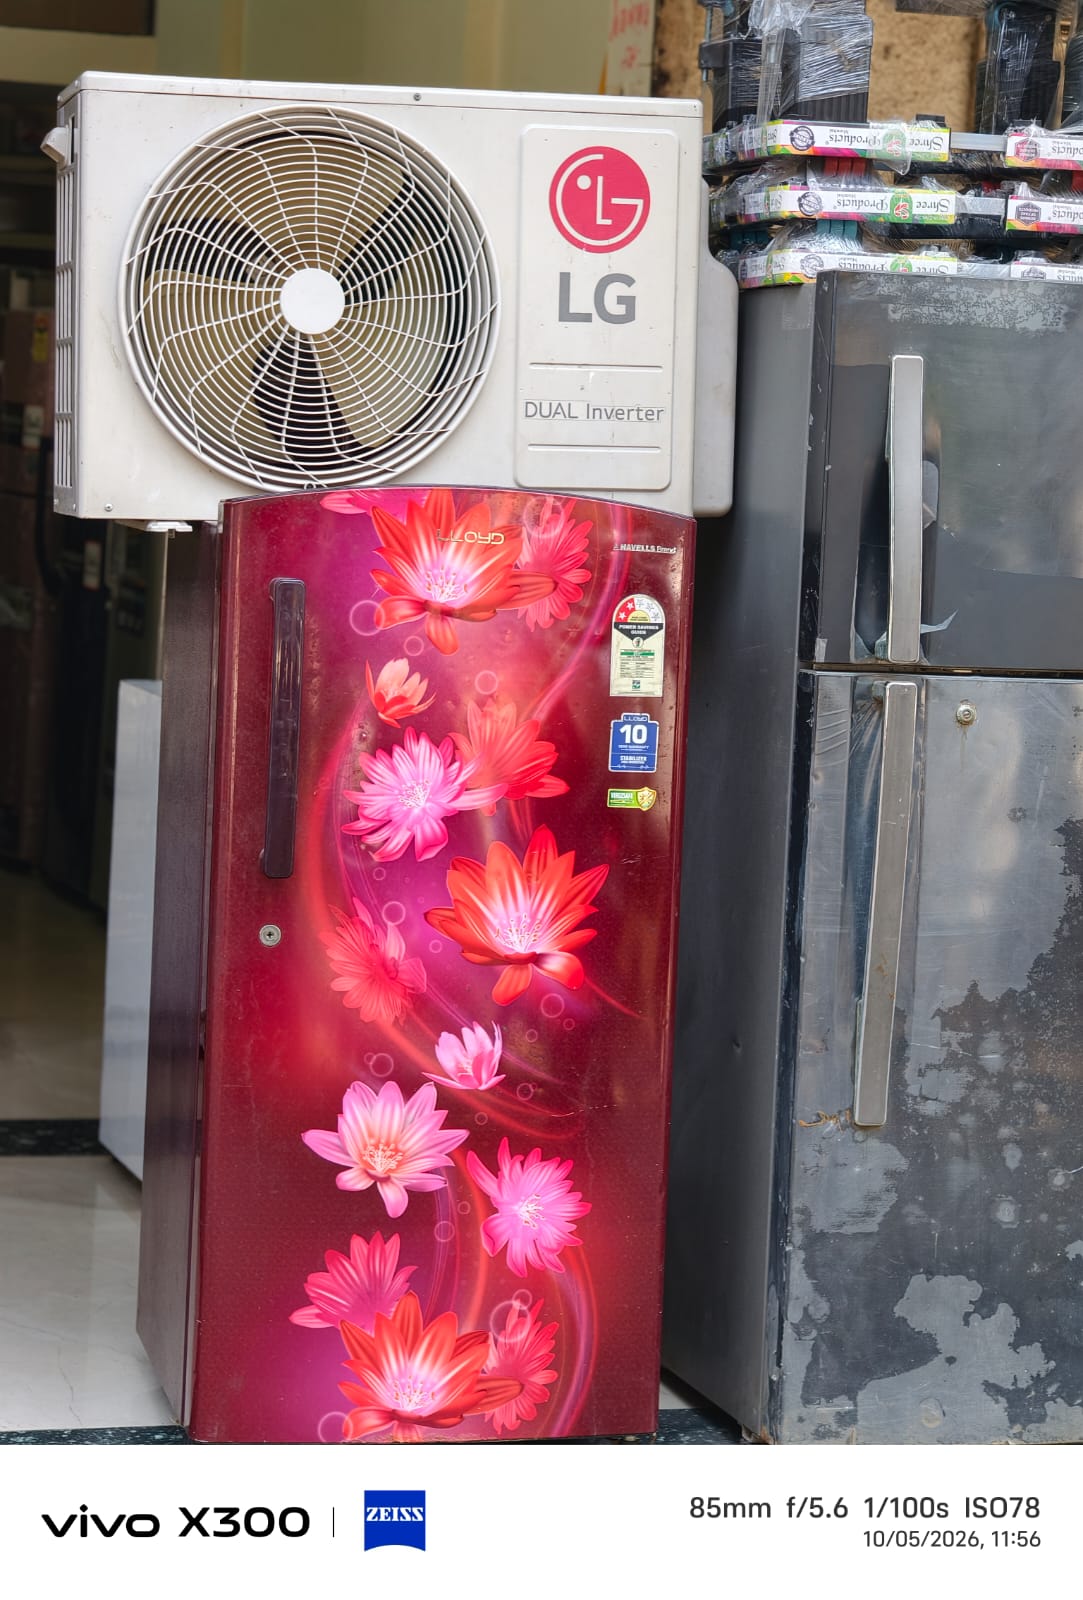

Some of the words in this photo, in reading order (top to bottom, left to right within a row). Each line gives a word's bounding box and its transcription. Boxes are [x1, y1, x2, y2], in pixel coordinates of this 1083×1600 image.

[908, 136, 944, 152] Shree
[556, 154, 643, 246] LG
[916, 198, 951, 213] Shree
[558, 272, 637, 324] LG
[524, 400, 578, 419] DUAL
[586, 402, 664, 422] Inverter
[437, 527, 505, 545] LLOYD
[620, 543, 656, 553] HAVELLS
[619, 724, 648, 744] 10
